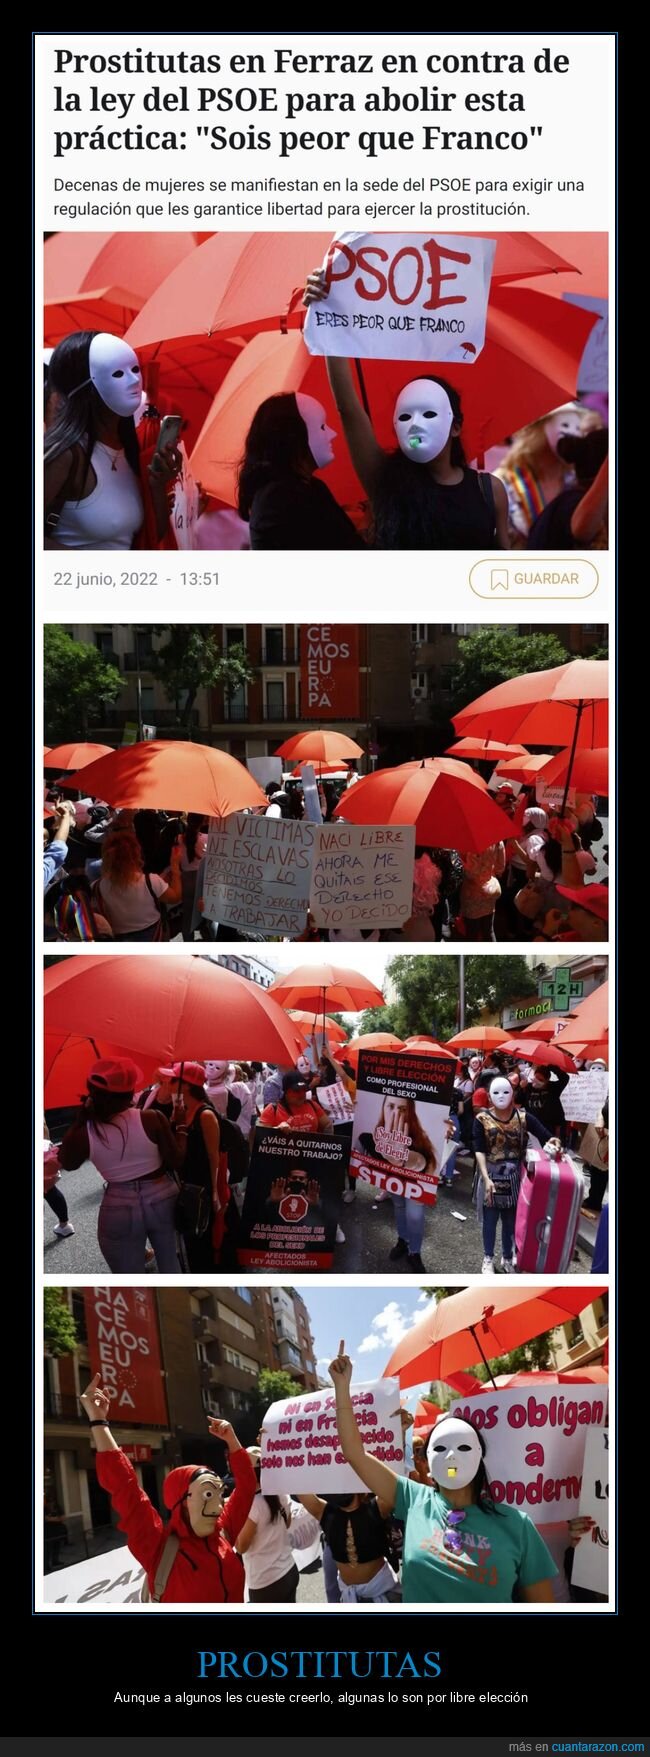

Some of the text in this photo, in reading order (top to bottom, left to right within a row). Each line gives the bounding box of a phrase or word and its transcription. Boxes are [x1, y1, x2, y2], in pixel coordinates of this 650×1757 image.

[323, 238, 471, 310] PSOE
[315, 311, 465, 333] ERES PEOR QUE FRANCO
[308, 643, 350, 658] MOS
[308, 660, 331, 675] EU
[309, 693, 331, 707] PA
[237, 817, 315, 846] VICTIMAS
[209, 837, 309, 869] NI ESCLAVAS
[315, 853, 398, 871] AHORA ME
[276, 868, 295, 882] LO
[373, 872, 402, 886] ESE
[204, 883, 260, 905] TENEMOS
[210, 904, 300, 931] A TRABAJAR
[321, 907, 343, 923] YO
[362, 1054, 452, 1073] POR MIS DERECHOS
[371, 1066, 395, 1077] LIBRE
[397, 1069, 447, 1083] ELECCIÓN
[366, 1076, 439, 1093] COMO PROFESIONAL
[382, 1087, 417, 1099] DEL SEXO
[258, 1145, 343, 1160] NUESTRO TRABAJO?
[296, 1139, 342, 1151] QUITARNOS
[358, 1165, 423, 1199] STOP
[95, 1302, 127, 1329] CE
[98, 1321, 149, 1355] MOS
[100, 1342, 131, 1367] EU
[295, 1417, 313, 1432] en
[507, 1396, 603, 1436] obligan
[267, 1436, 302, 1452] hemos
[285, 1454, 304, 1467] nos
[308, 1452, 331, 1466] han
[525, 1443, 544, 1466] a
